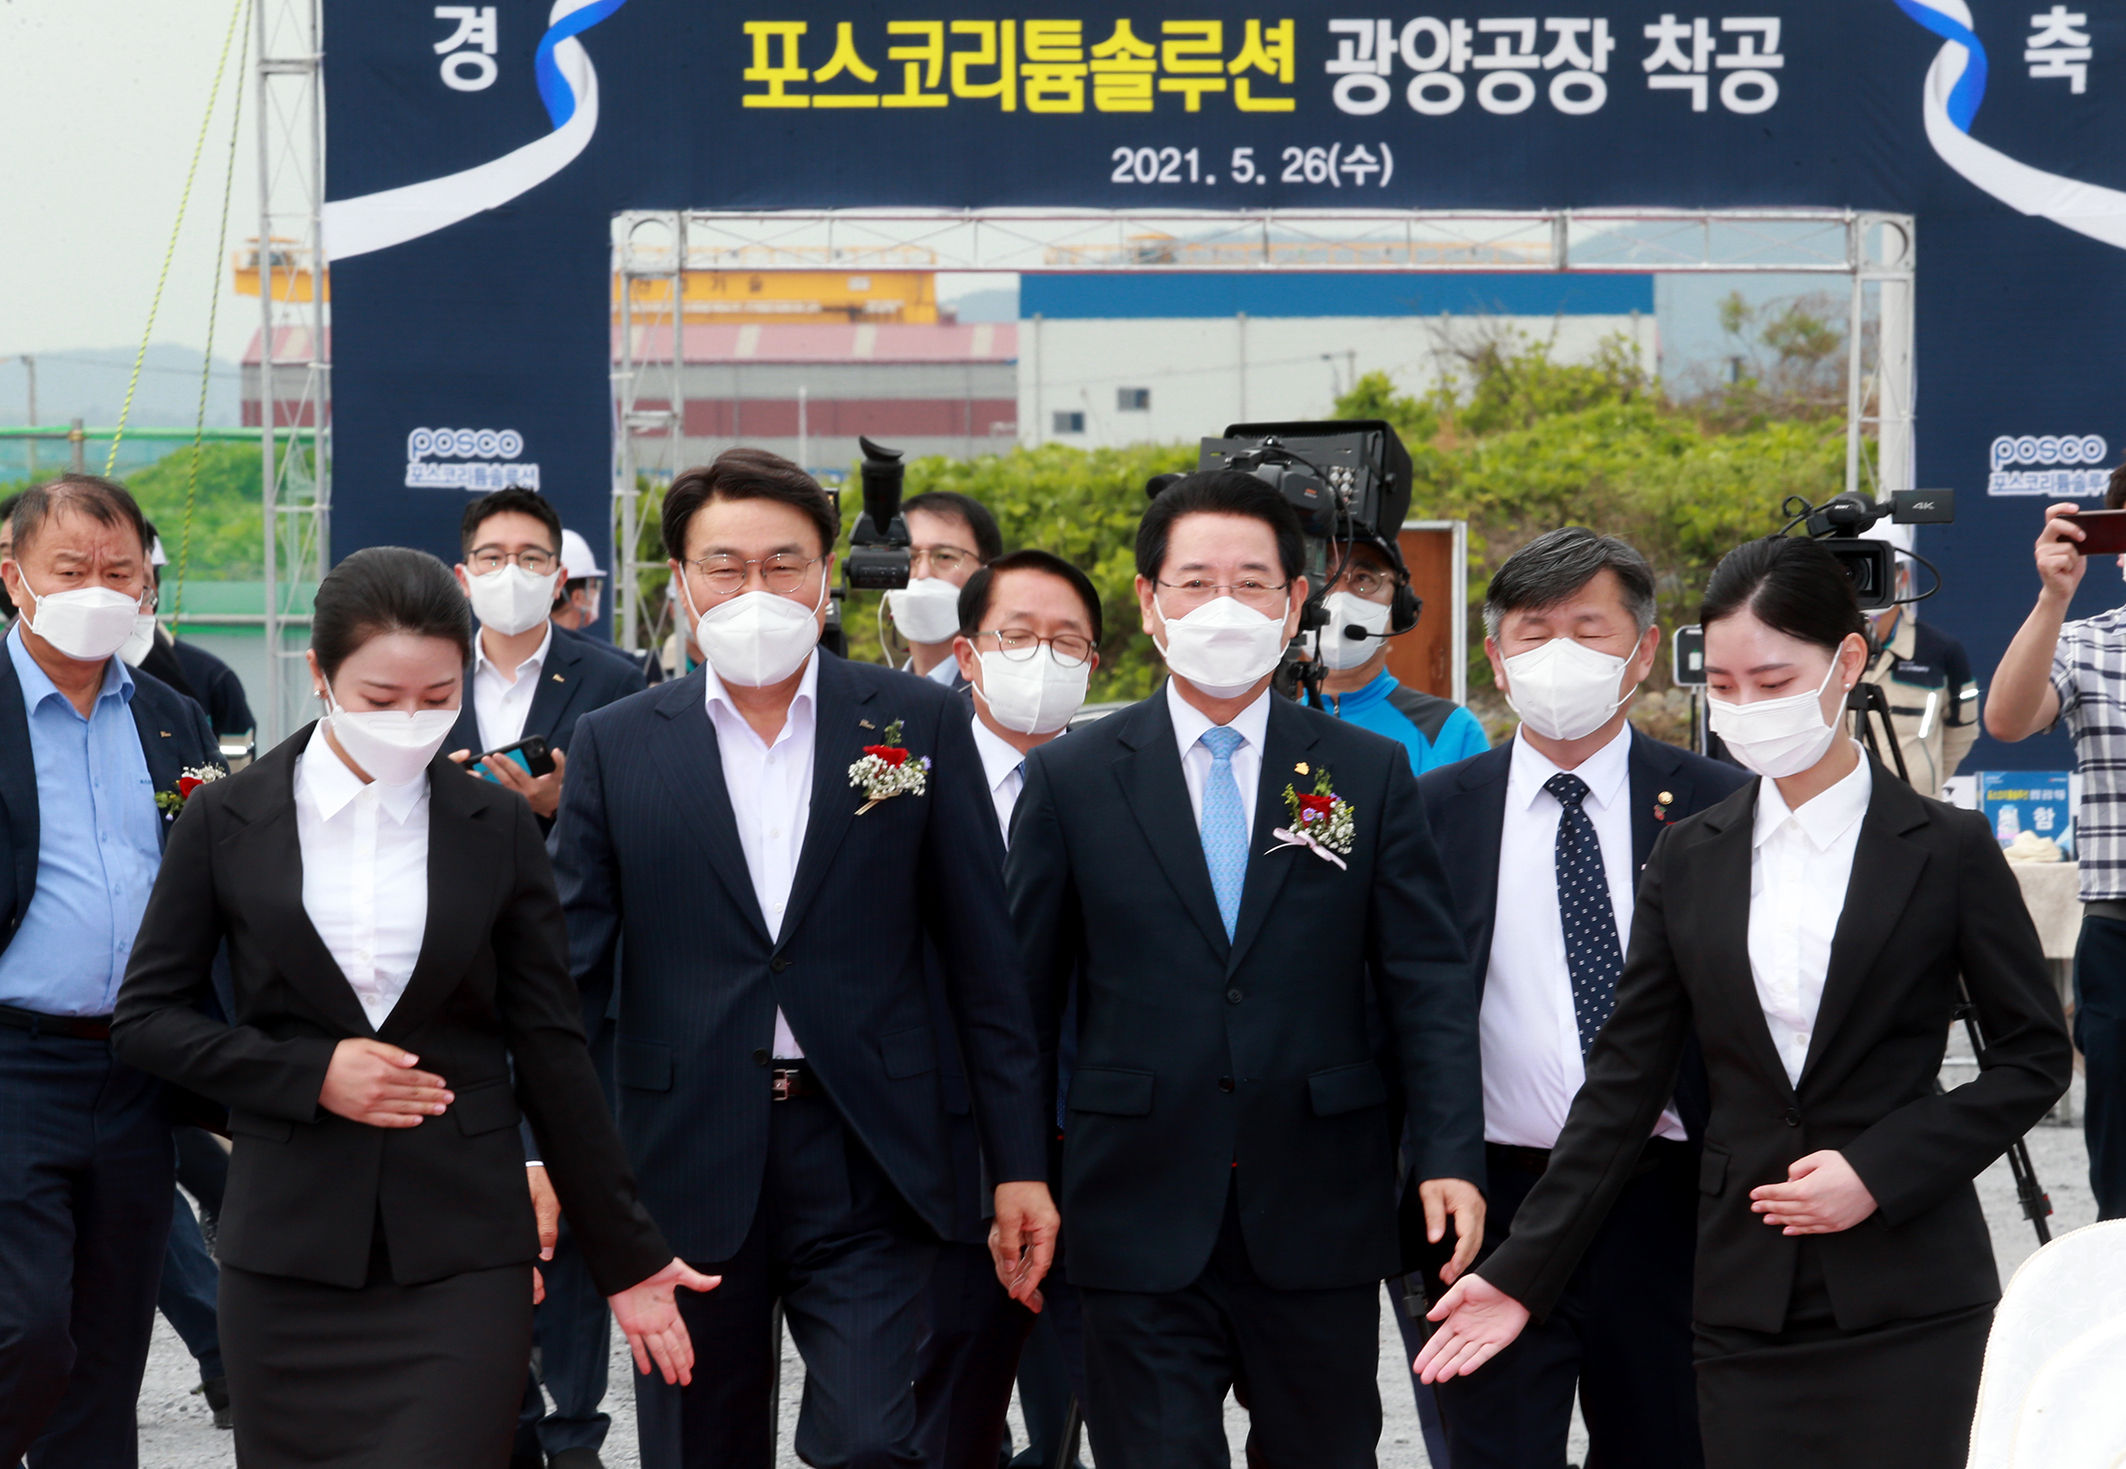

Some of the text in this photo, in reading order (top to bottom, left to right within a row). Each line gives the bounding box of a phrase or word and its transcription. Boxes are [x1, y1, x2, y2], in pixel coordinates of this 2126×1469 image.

[433, 5, 498, 92] 경
[742, 14, 1784, 115] 포스코리튬솔루션 광양공장 착공
[2024, 4, 2093, 95] 축
[1111, 141, 1394, 188] 2021. 5. 26(수)
[408, 427, 523, 462] posco
[1990, 435, 2107, 471] posco
[1988, 469, 2112, 497] 포스코리튬솔루
[1912, 501, 1936, 511] 4K
